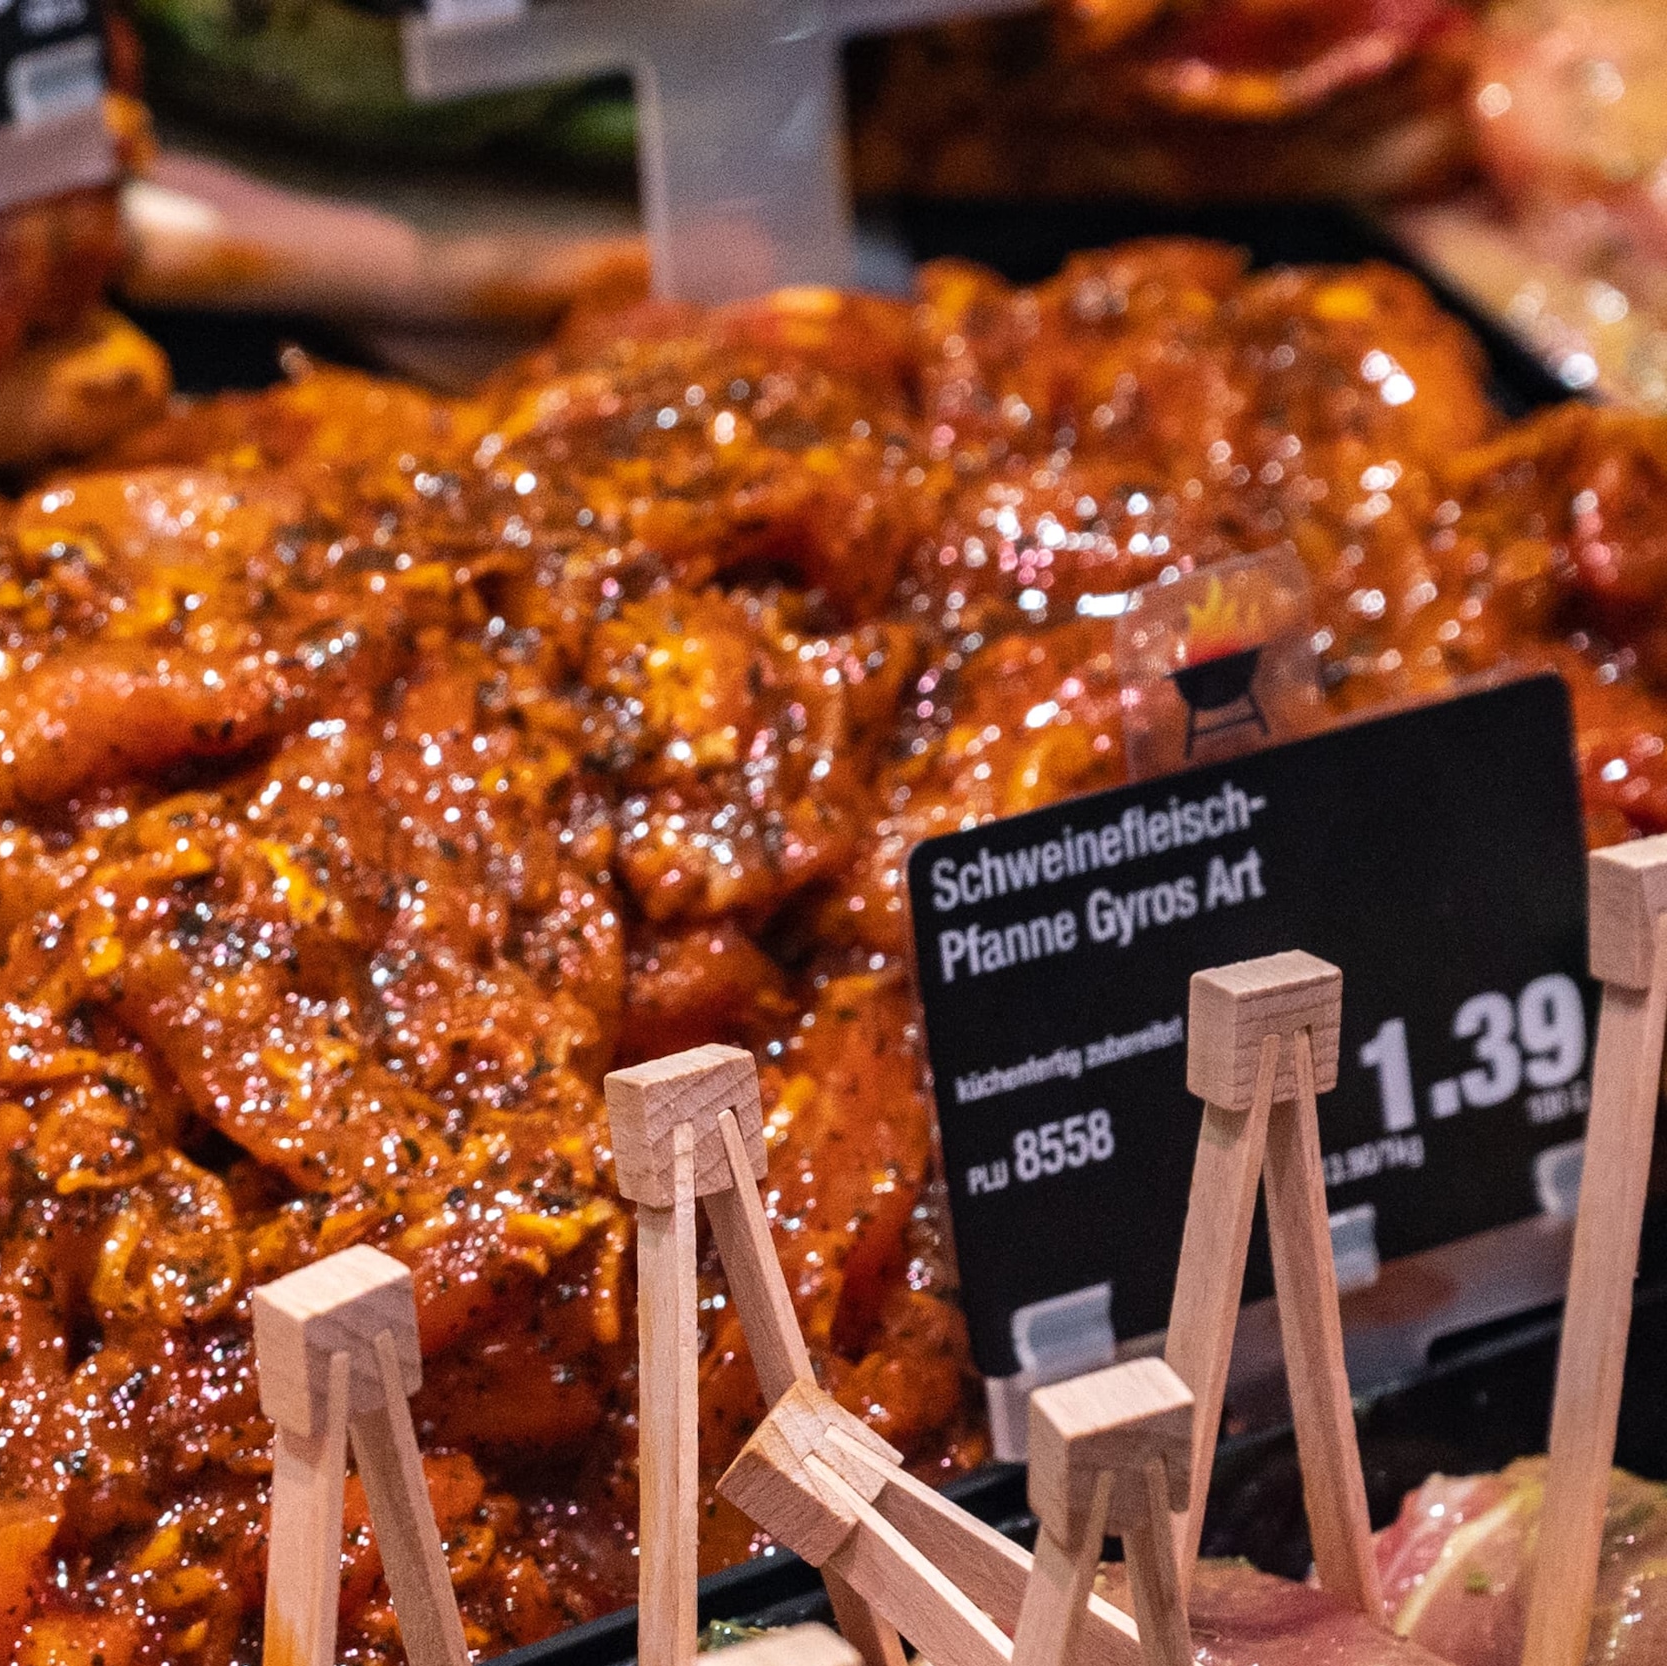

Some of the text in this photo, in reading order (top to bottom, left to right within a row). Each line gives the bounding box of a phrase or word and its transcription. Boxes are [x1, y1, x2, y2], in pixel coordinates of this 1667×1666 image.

[931, 783, 1266, 911] Schweinefleisch-
[939, 849, 1265, 981] Pfanne Gyros Art
[955, 1017, 1182, 1102] küchenfertig zubereitet
[1360, 974, 1585, 1131] 1.39
[967, 1110, 1114, 1194] PLU 8558
